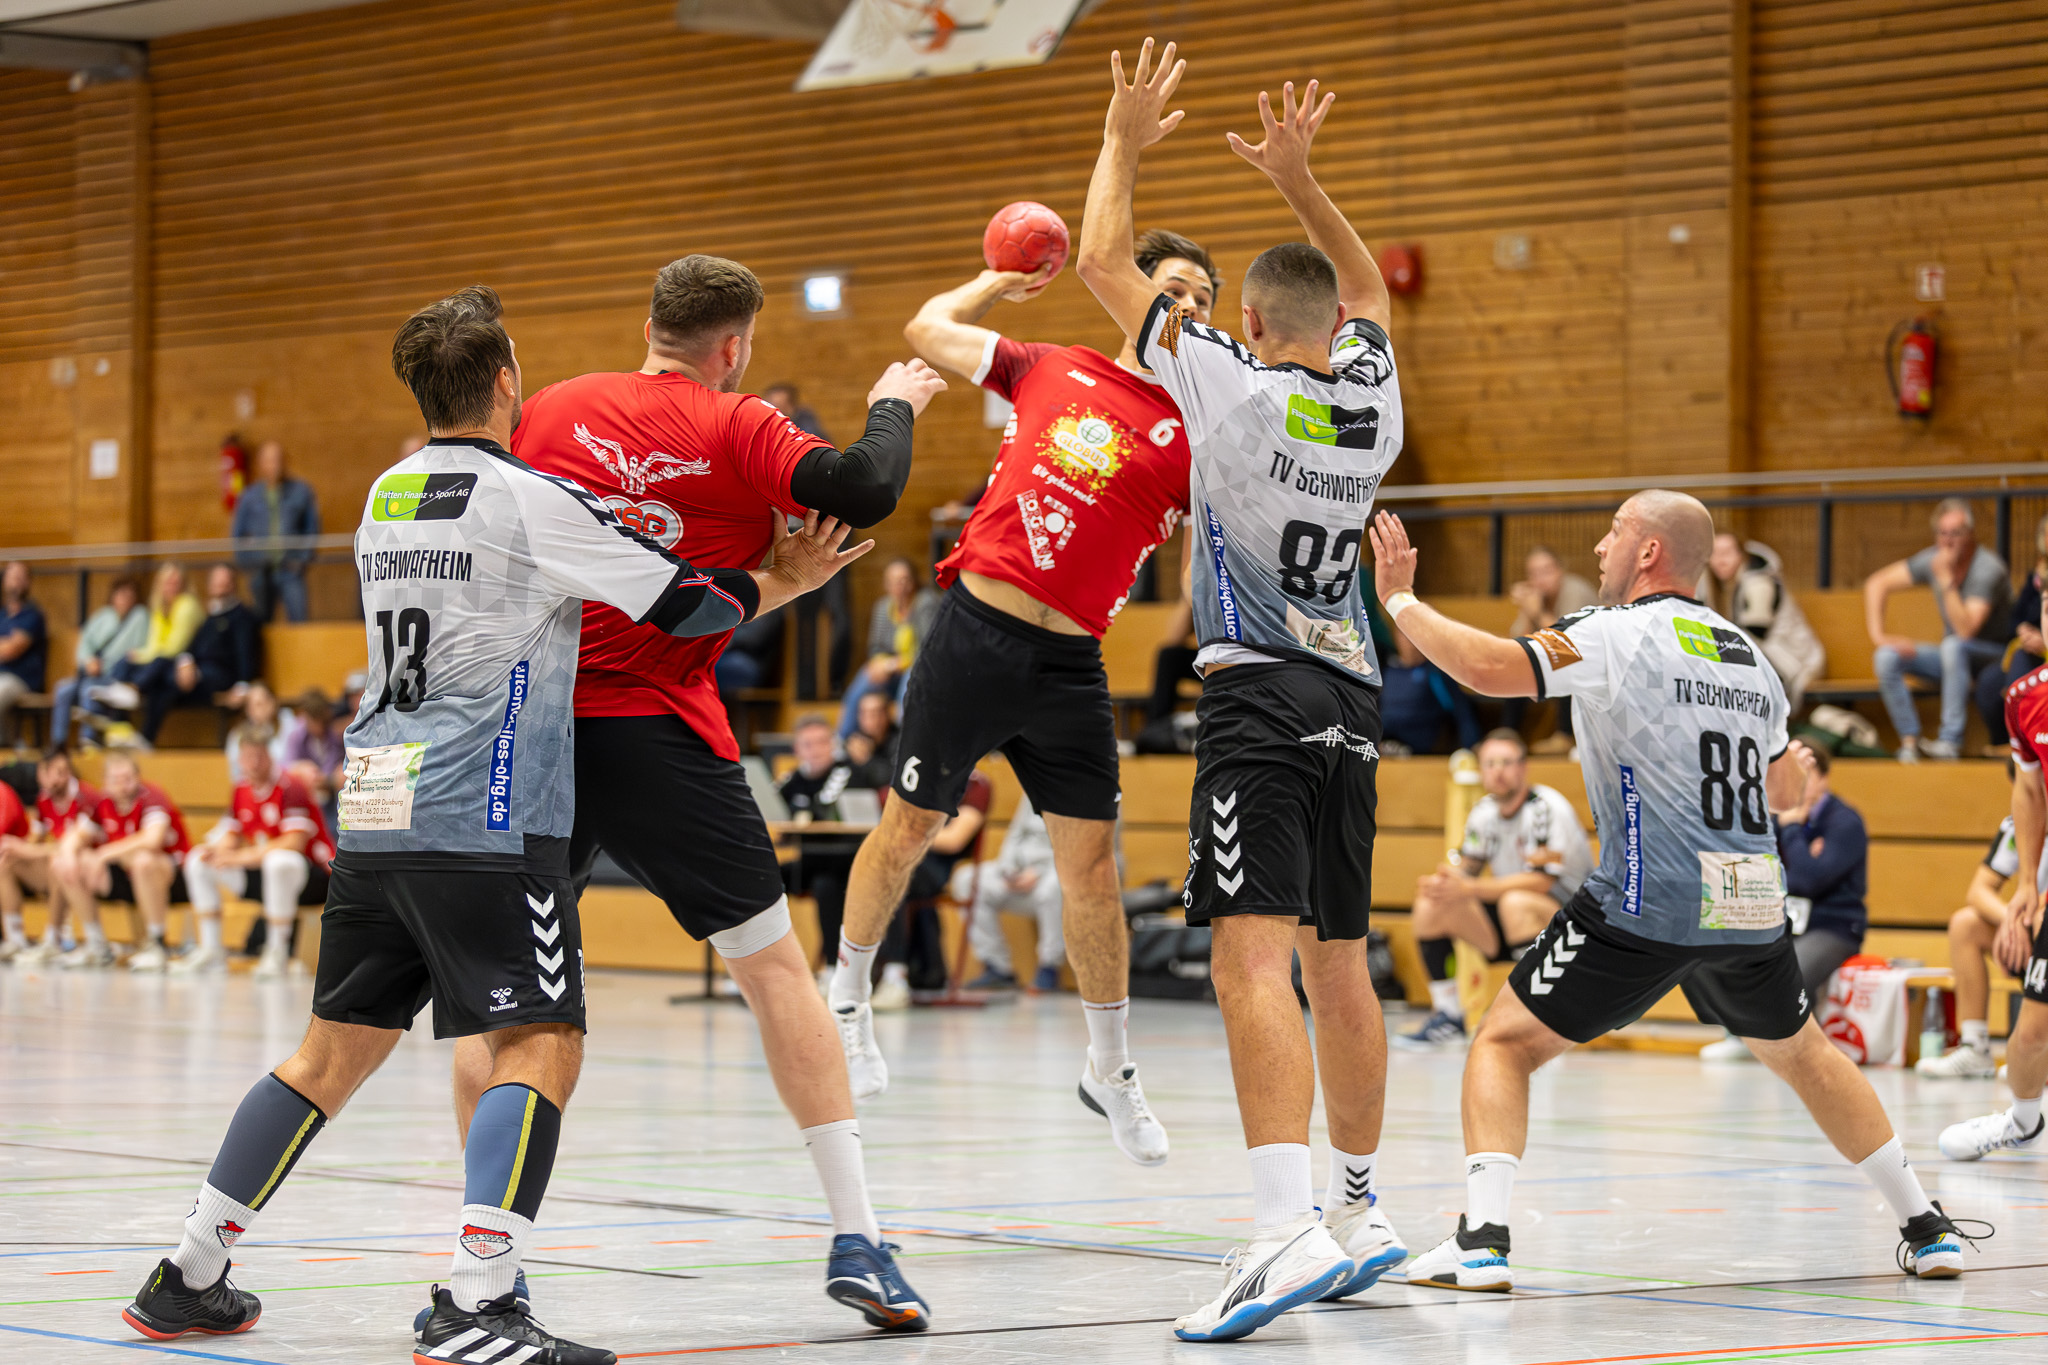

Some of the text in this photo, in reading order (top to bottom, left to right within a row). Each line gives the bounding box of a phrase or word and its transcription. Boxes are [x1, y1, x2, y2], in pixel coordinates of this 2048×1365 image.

[1149, 417, 1182, 447] 6
[1058, 434, 1106, 467] GLOBUS
[1269, 450, 1295, 484] TV
[377, 490, 402, 499] Flatten
[403, 491, 427, 499] Finanz
[435, 489, 455, 500] Sport
[456, 488, 469, 497] AG
[361, 549, 473, 583] TV SCHWAFHEIM
[1277, 519, 1363, 605] 83
[376, 607, 430, 713] 13
[1674, 678, 1771, 722] TV SCHWAFHEIM
[900, 755, 922, 793] 6
[1699, 731, 1768, 835] 88
[2024, 956, 2048, 994] 14
[489, 1001, 518, 1012] hummel
